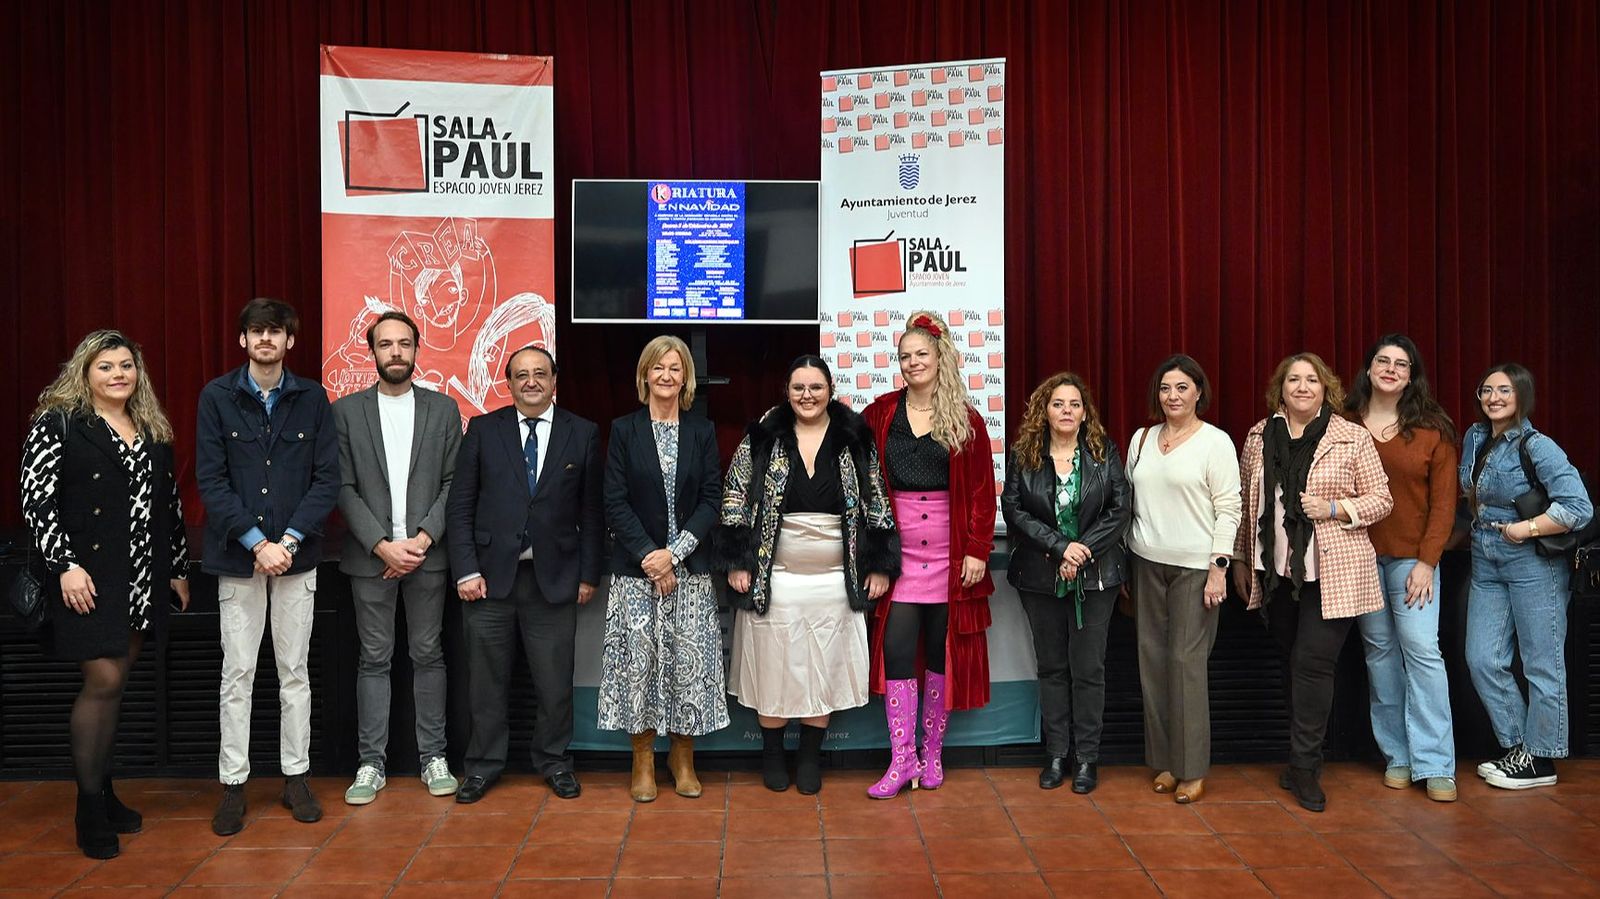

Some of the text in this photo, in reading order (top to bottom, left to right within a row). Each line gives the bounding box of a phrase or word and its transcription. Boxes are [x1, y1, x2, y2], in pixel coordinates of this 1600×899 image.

[434, 116, 497, 140] SALA
[434, 132, 542, 180] PAÚL
[434, 181, 543, 196] ESPACIO JOVEN JEREZ
[840, 194, 976, 210] Ayuntamiento de Jerez
[887, 208, 928, 221] Juventud
[398, 223, 475, 270] CREA
[909, 238, 942, 250] SALA
[909, 245, 966, 272] PAÚL
[909, 272, 950, 280] ESPACIO JOVEN
